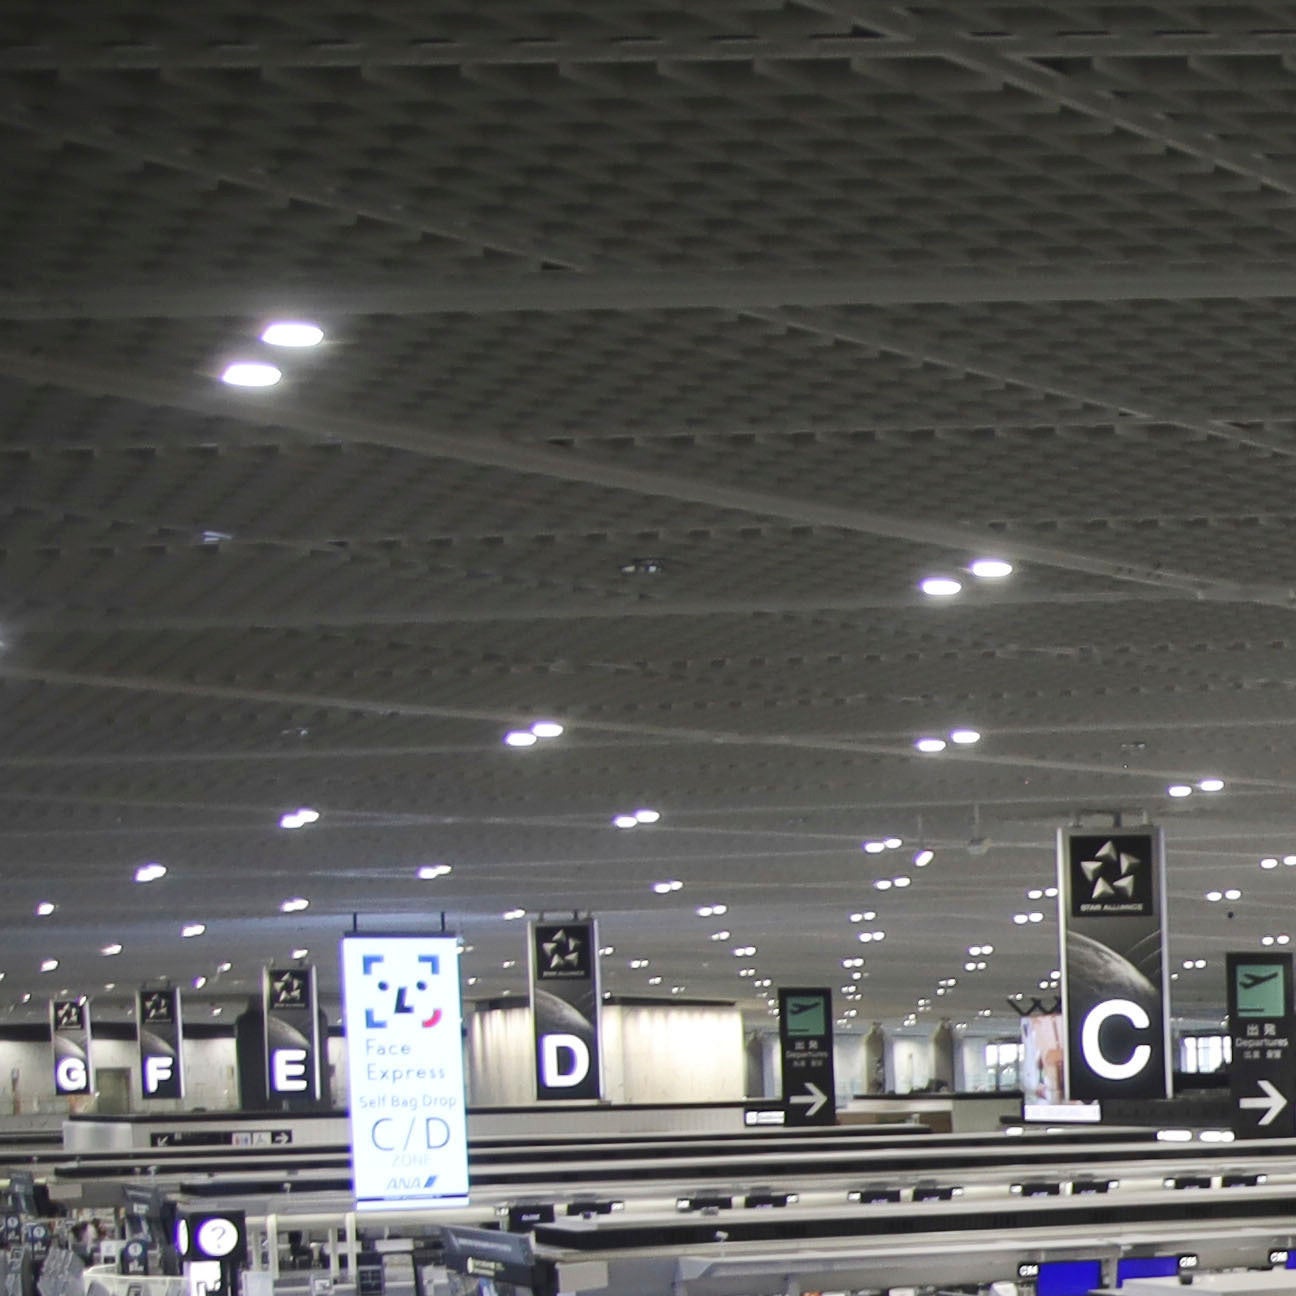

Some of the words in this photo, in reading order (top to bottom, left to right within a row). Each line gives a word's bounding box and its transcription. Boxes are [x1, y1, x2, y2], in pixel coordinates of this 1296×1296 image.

[365, 1039, 411, 1056] Face
[1081, 999, 1151, 1080] C
[1235, 1038, 1289, 1049] Departures
[57, 1056, 87, 1091] G
[145, 1056, 173, 1093] F
[273, 1049, 308, 1092] E
[366, 1063, 446, 1084] Express
[542, 1033, 590, 1088] D
[359, 1094, 386, 1109] Self
[391, 1095, 418, 1111] Bag
[422, 1094, 457, 1110] Drop
[386, 1177, 422, 1191] ANA
